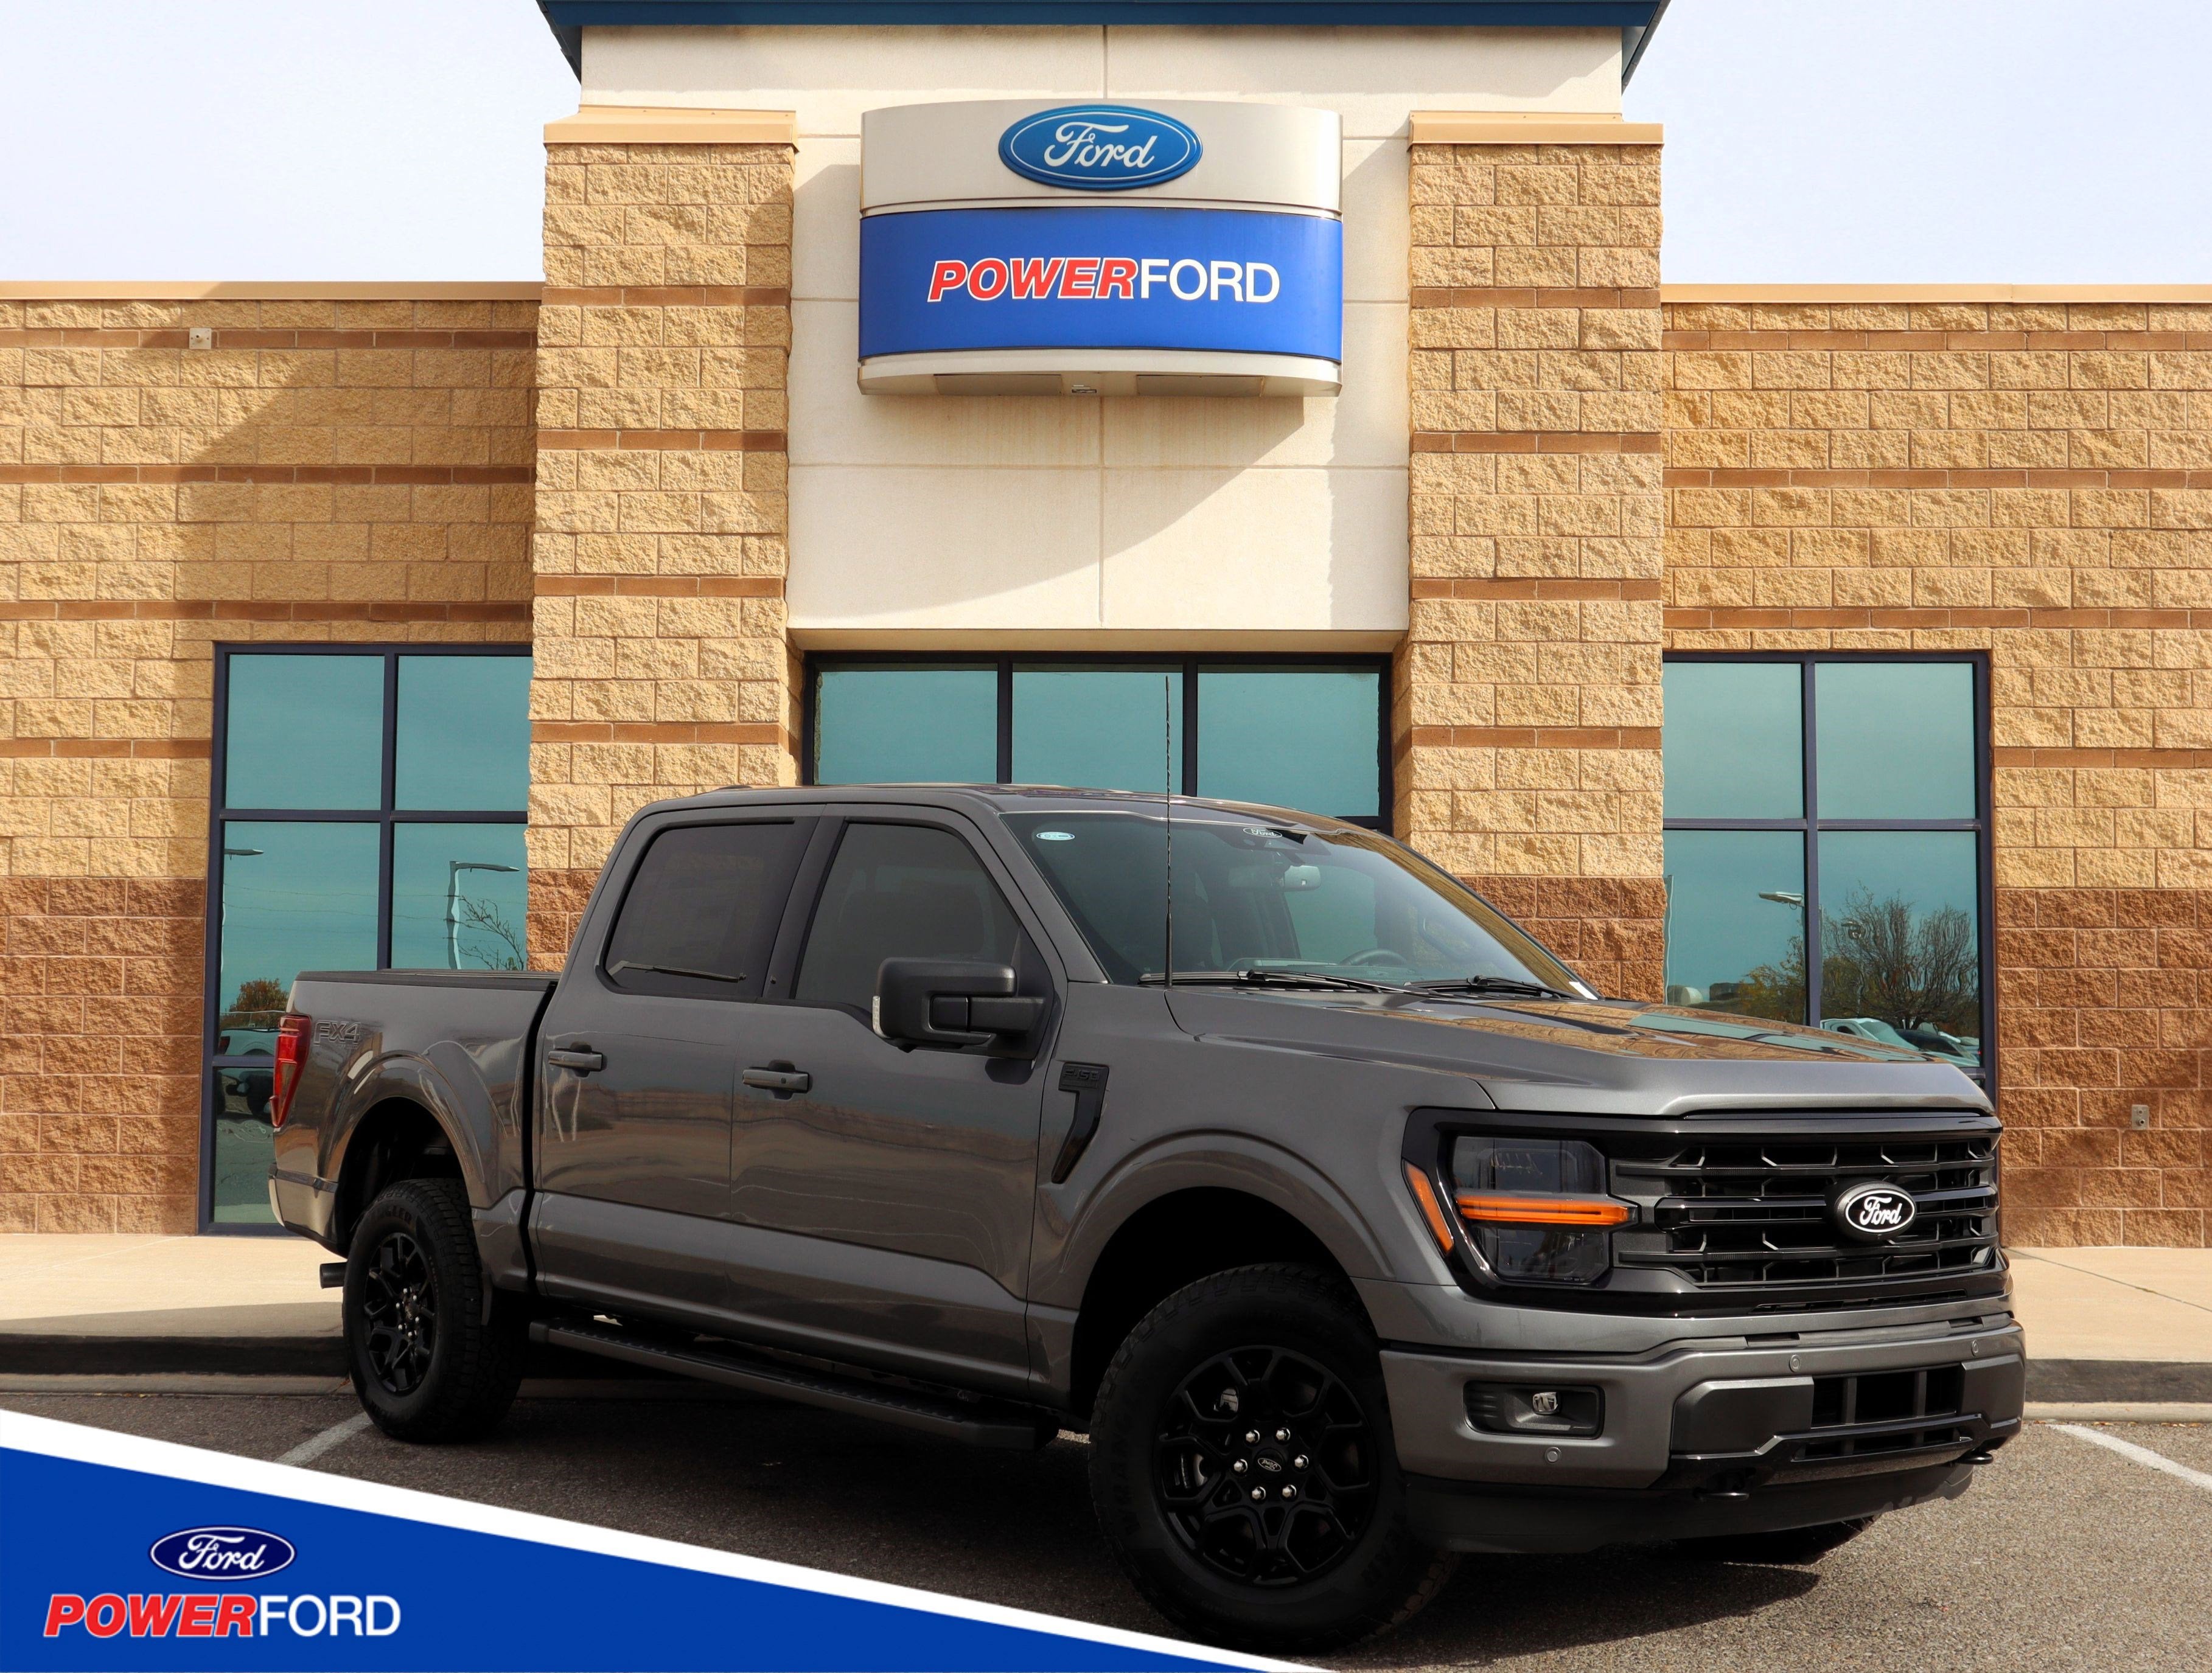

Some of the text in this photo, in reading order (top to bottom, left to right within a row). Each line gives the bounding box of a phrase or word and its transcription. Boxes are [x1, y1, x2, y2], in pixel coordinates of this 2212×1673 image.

[1044, 121, 1154, 169] Ford
[313, 1020, 361, 1046] FX4
[1859, 1196, 1903, 1226] Ford
